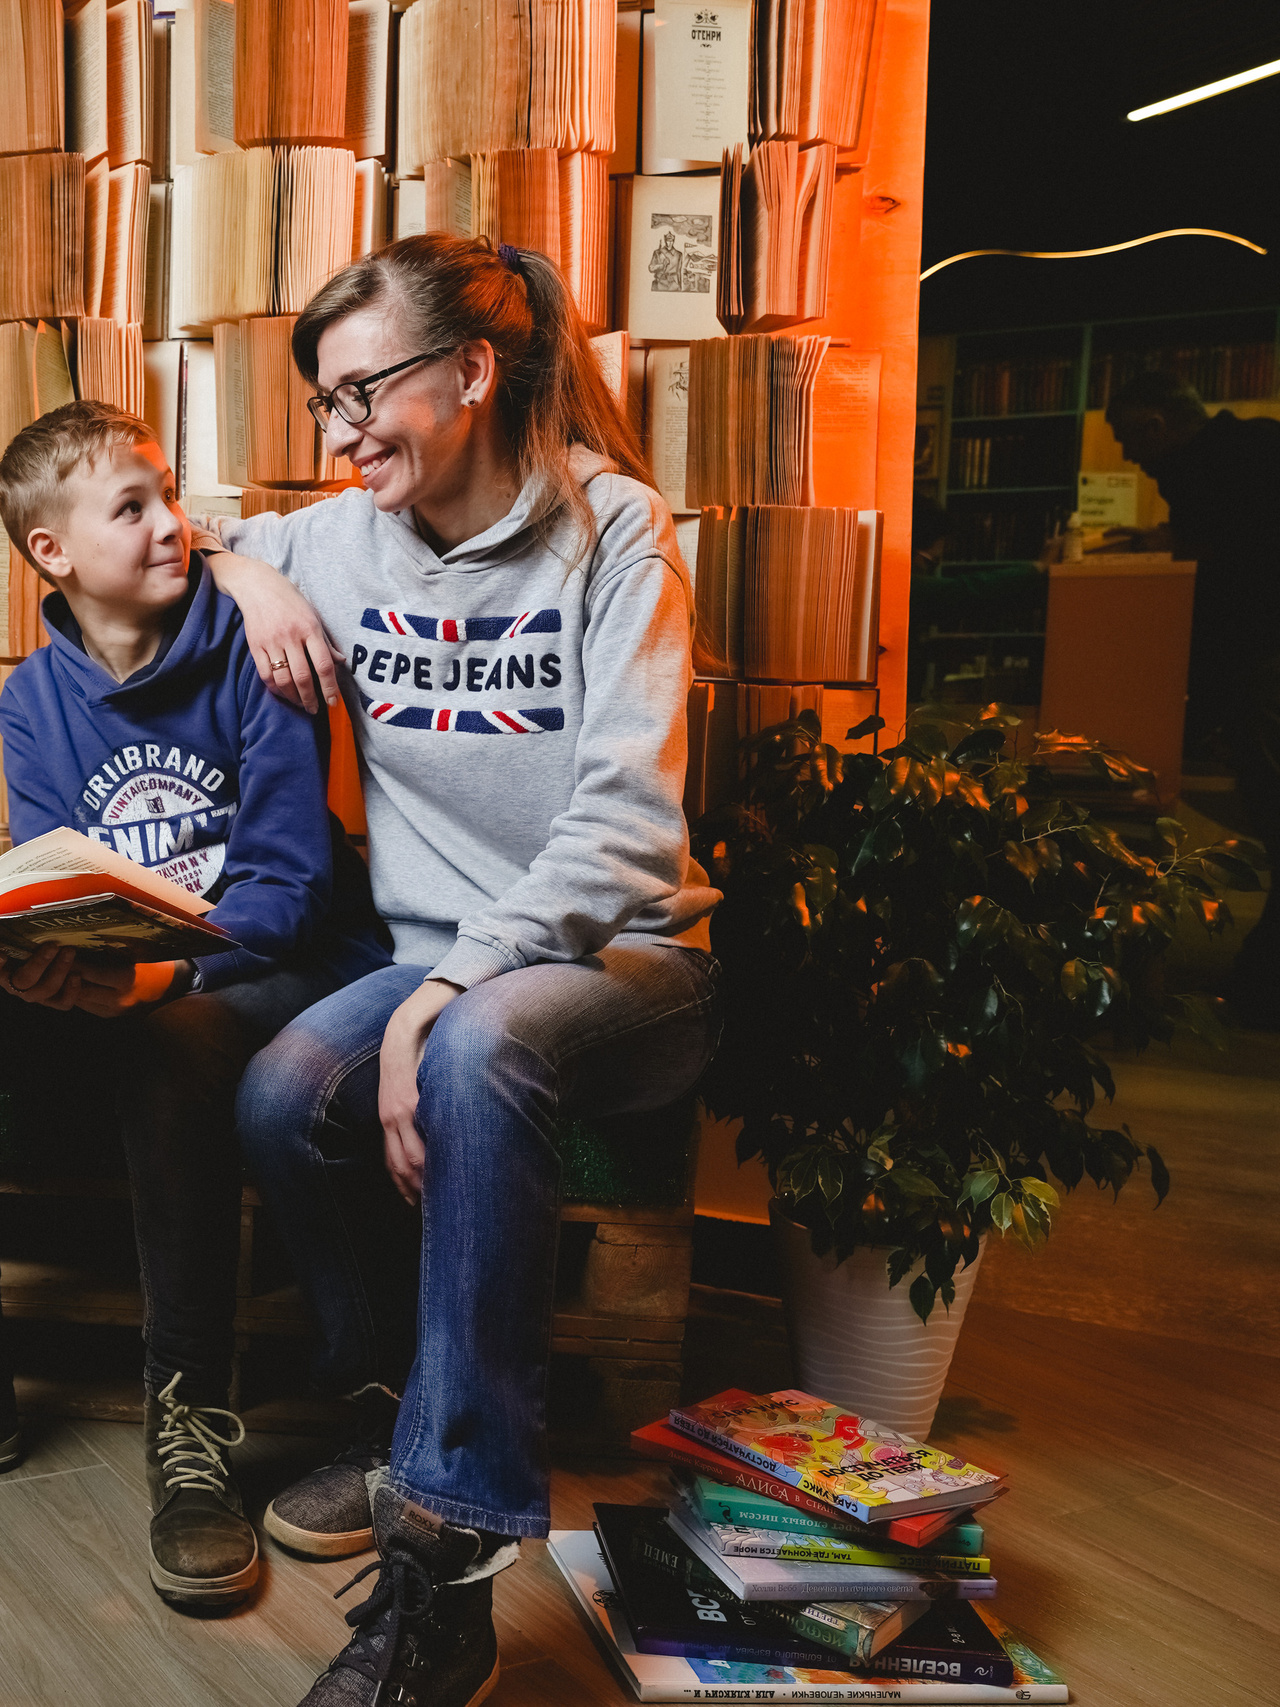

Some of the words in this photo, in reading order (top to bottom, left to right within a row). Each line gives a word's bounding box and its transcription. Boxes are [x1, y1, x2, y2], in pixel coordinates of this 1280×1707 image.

[351, 643, 433, 691] PEPE
[442, 653, 562, 692] JEANS
[28, 913, 111, 928] ПАКС
[711, 1407, 757, 1419] САРА
[759, 1399, 800, 1411] УИКС
[674, 1415, 697, 1433] ТЕБЯ
[697, 1427, 712, 1441] ДО
[711, 1434, 777, 1472] ДОСТУЧАТЬСЯ
[818, 1449, 933, 1478] ДОСТУЧАТЬСЯ
[857, 1471, 884, 1482] ДО
[880, 1462, 927, 1476] ТЕБЯ
[735, 1473, 790, 1502] АЛИСА
[803, 1480, 830, 1499] УИКС
[832, 1494, 858, 1513] САРА
[409, 1510, 435, 1530] ROXY
[739, 1511, 778, 1523] писем
[782, 1516, 828, 1529] еловых
[643, 1543, 679, 1569] ЕМЕЦ
[733, 1546, 757, 1554] МОРЕ
[759, 1547, 813, 1558] КОНЧАЕТСЯ
[812, 1551, 830, 1559] ГДЕ
[831, 1552, 852, 1561] ТАМ,
[900, 1556, 931, 1567] НЕСС
[935, 1560, 980, 1571] ПАТРИК
[752, 1584, 776, 1593] Холли
[778, 1584, 798, 1592] Вебб
[801, 1582, 839, 1593] Девочка
[735, 1647, 771, 1659] ВЗРЫВА
[774, 1650, 823, 1662] БОЛЬШОГО
[791, 1691, 844, 1699] ЧЕЛОВЕЧКИ
[847, 1690, 901, 1699] МАЛЕНЬКИЕ
